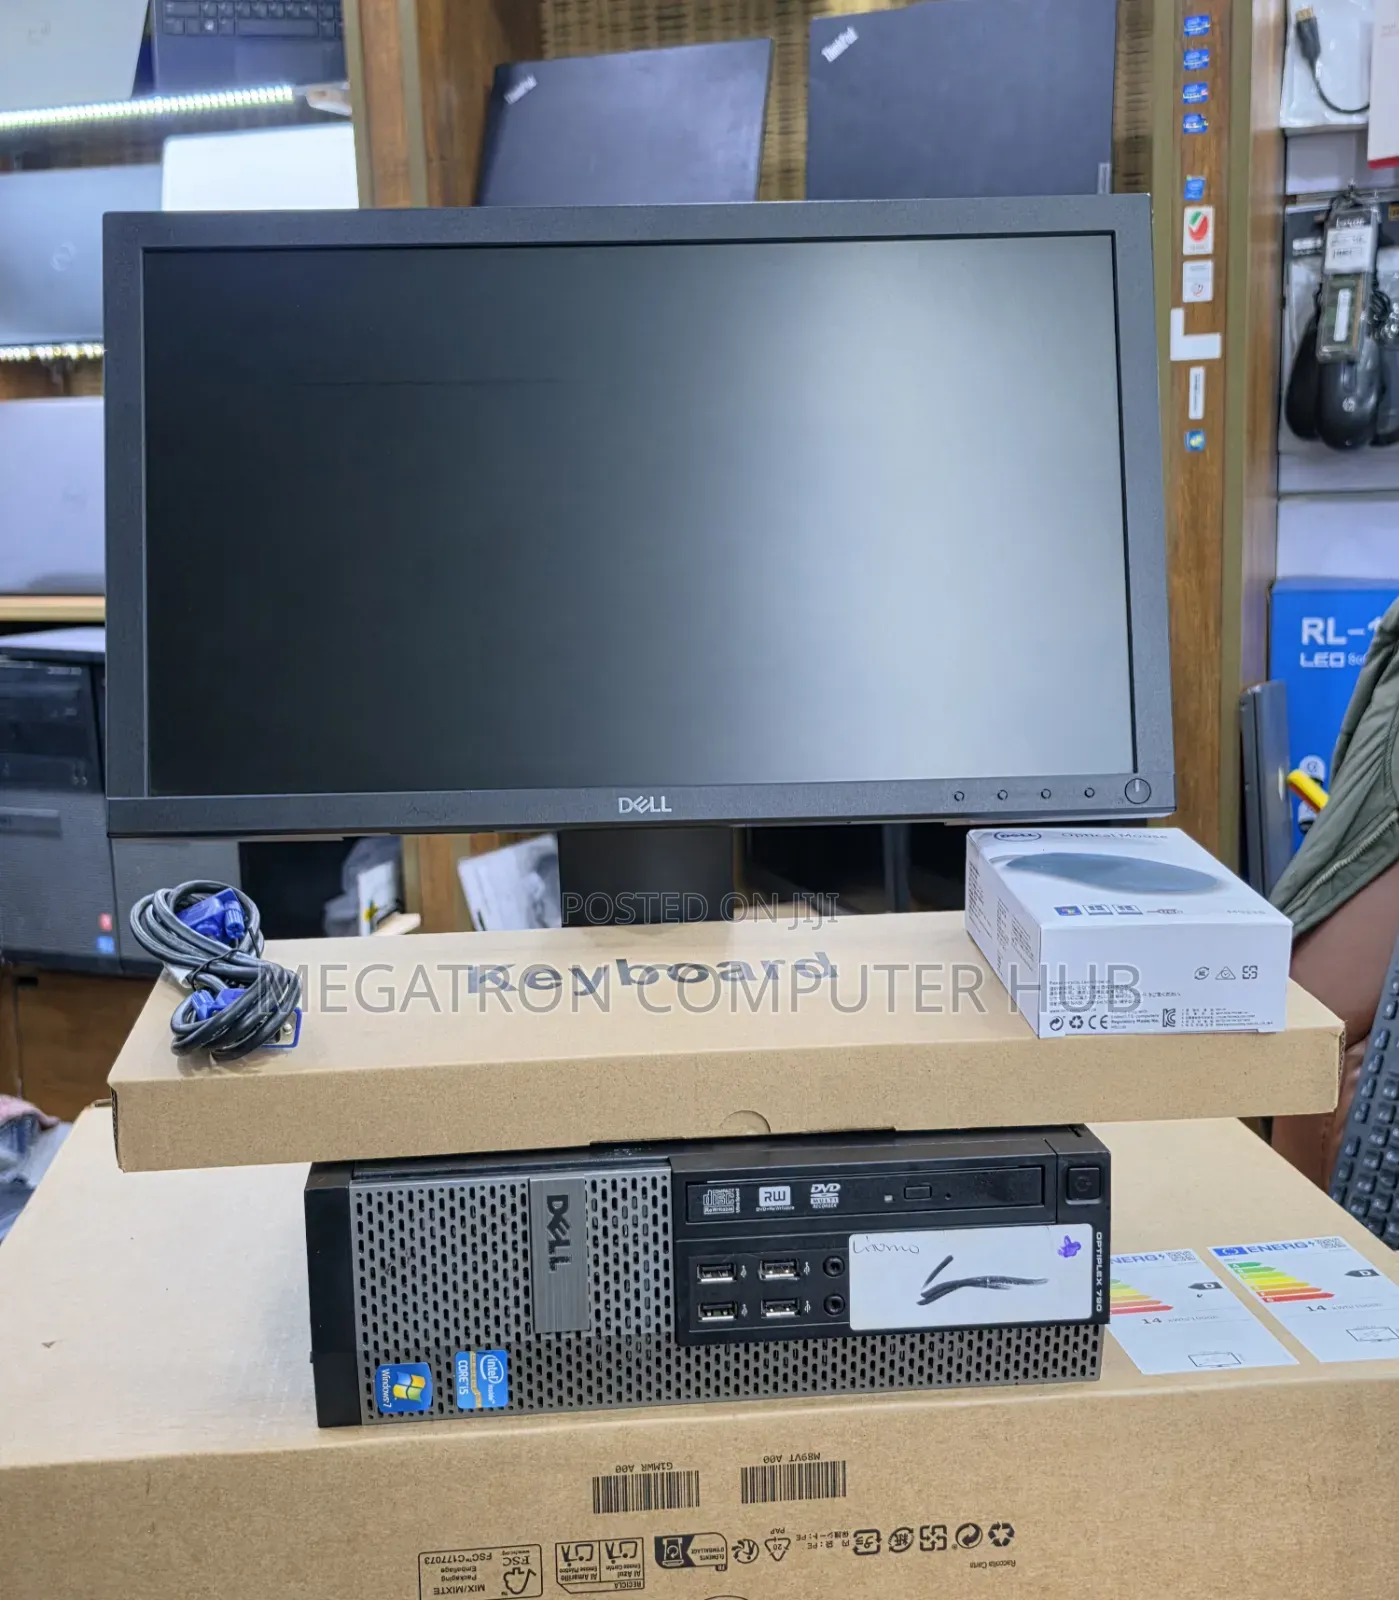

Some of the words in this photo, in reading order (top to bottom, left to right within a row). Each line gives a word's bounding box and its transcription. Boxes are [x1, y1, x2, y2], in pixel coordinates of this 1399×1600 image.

[1300, 651, 1345, 668] LED
[618, 795, 672, 814] DELL
[468, 952, 839, 997] Keyboard
[811, 1183, 841, 1193] DVD
[764, 1191, 786, 1202] RW
[547, 1194, 572, 1272] DELL
[1109, 1254, 1158, 1264] NERG
[1305, 1304, 1327, 1312] 14
[789, 1452, 821, 1462] M89VT
[641, 1462, 673, 1471] G1MWR
[502, 1556, 531, 1566] FSC
[440, 1574, 477, 1582] Packaging
[433, 1584, 485, 1595] MIX/MIXTE
[614, 1581, 641, 1589] RECICLA
